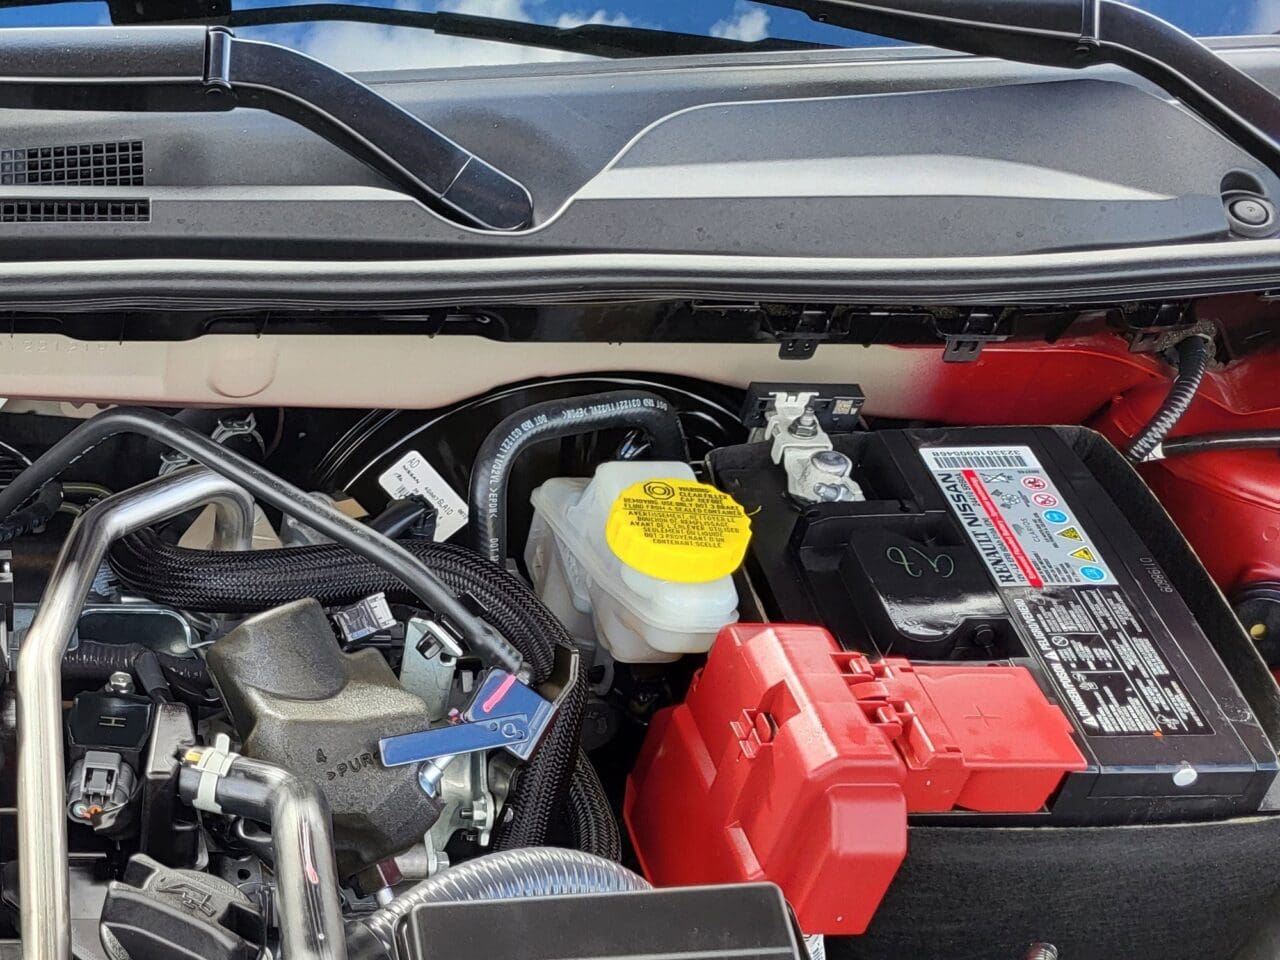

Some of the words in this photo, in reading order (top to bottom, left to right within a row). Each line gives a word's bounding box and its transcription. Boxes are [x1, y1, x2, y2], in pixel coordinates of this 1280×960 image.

[936, 473, 982, 526] NISSAN
[1019, 517, 1041, 542] CLARIOS
[970, 530, 1016, 583] RENAULT
